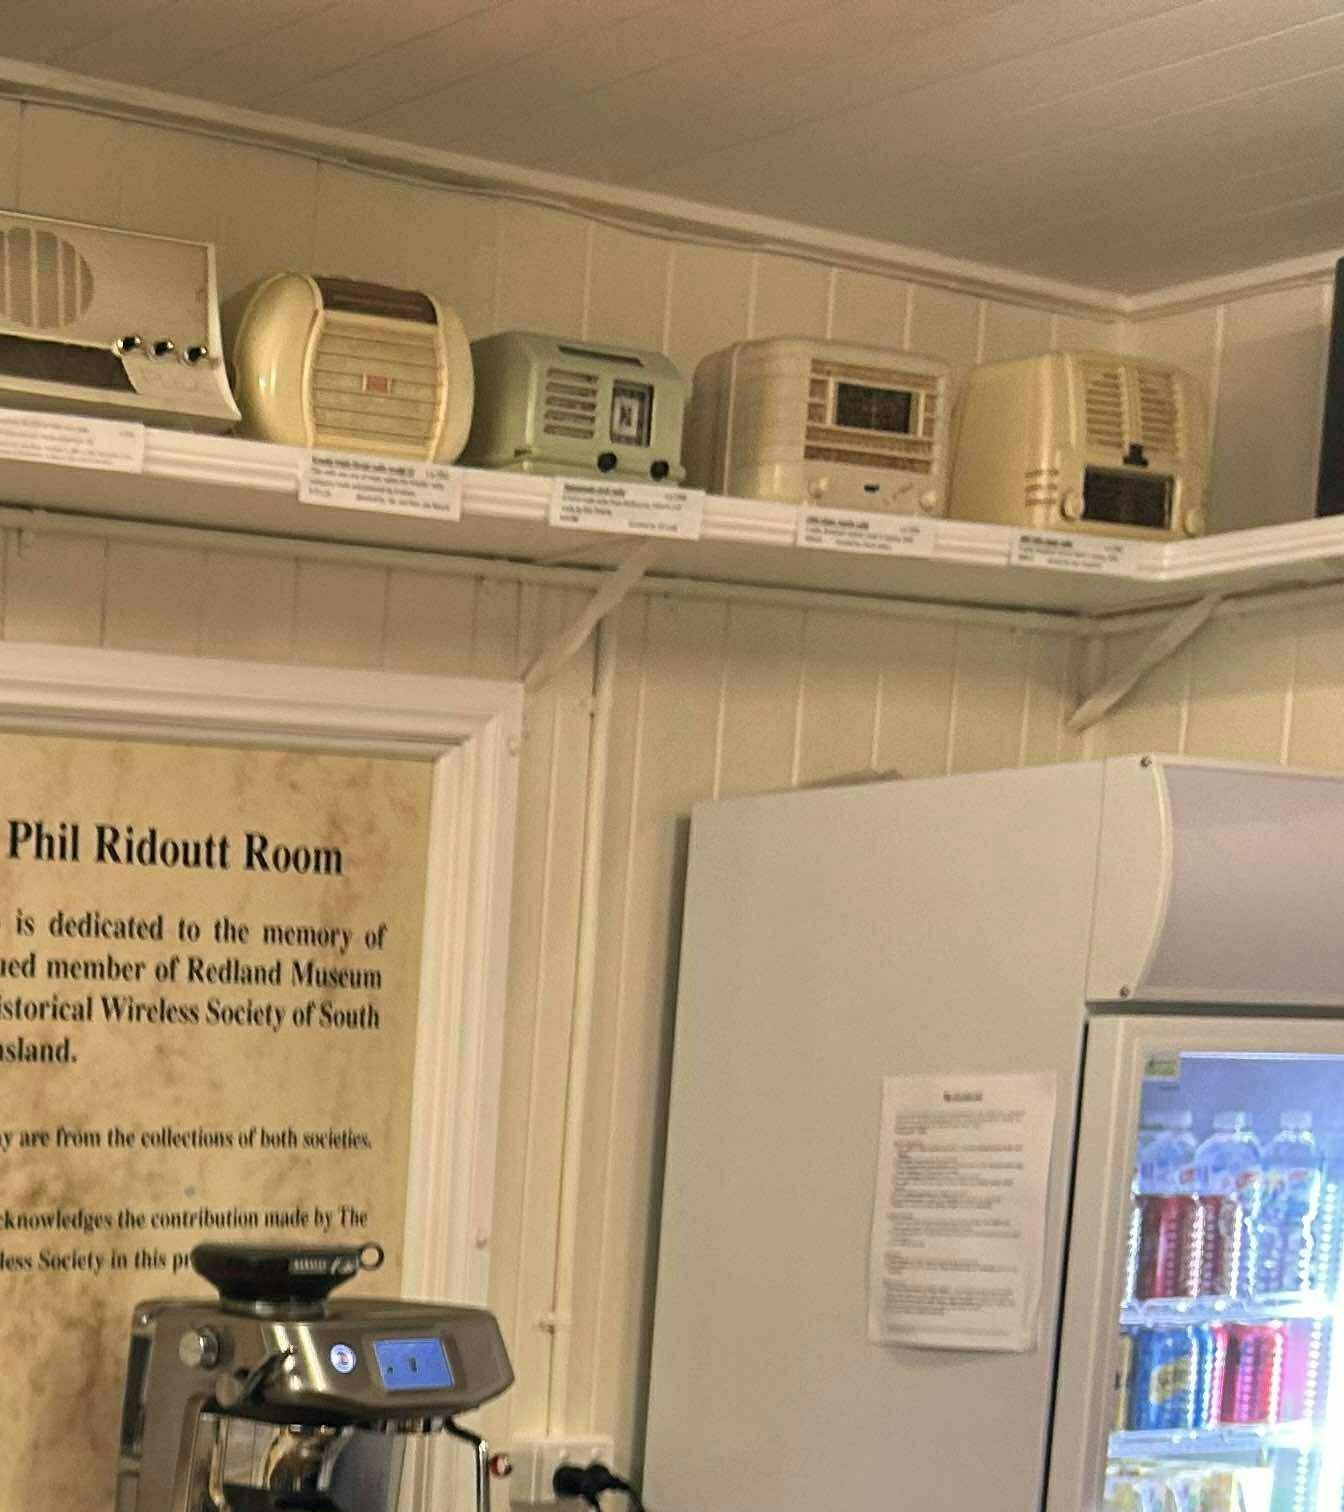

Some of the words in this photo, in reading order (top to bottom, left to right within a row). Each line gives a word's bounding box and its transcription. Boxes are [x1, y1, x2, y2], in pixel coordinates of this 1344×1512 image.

[7, 818, 81, 864] Phil
[95, 824, 231, 871] Ridoutt
[243, 831, 345, 876] Room
[16, 910, 34, 936] is
[48, 910, 164, 942] dedicated
[178, 916, 201, 942] to
[214, 915, 250, 945] the
[262, 922, 353, 955] memory
[364, 921, 389, 950] of
[46, 955, 146, 983] member
[154, 956, 181, 983] of
[186, 958, 282, 988] Redland
[291, 961, 383, 990] Museum
[101, 995, 200, 1026] Wireless
[204, 999, 286, 1033] Society
[292, 1000, 315, 1028] of
[319, 1001, 381, 1031] South
[19, 1131, 50, 1149] are
[55, 1126, 102, 1149] from
[107, 1126, 136, 1150] the
[140, 1127, 234, 1151] collections
[238, 1126, 257, 1150] of
[259, 1127, 298, 1151] both
[303, 1128, 372, 1151] societies.
[117, 1207, 146, 1231] the
[150, 1206, 259, 1230] contribution
[264, 1205, 309, 1229] made
[313, 1205, 333, 1233] by
[339, 1204, 369, 1229] The
[38, 1249, 105, 1276] Society
[109, 1250, 129, 1270] in
[133, 1248, 167, 1270] this
